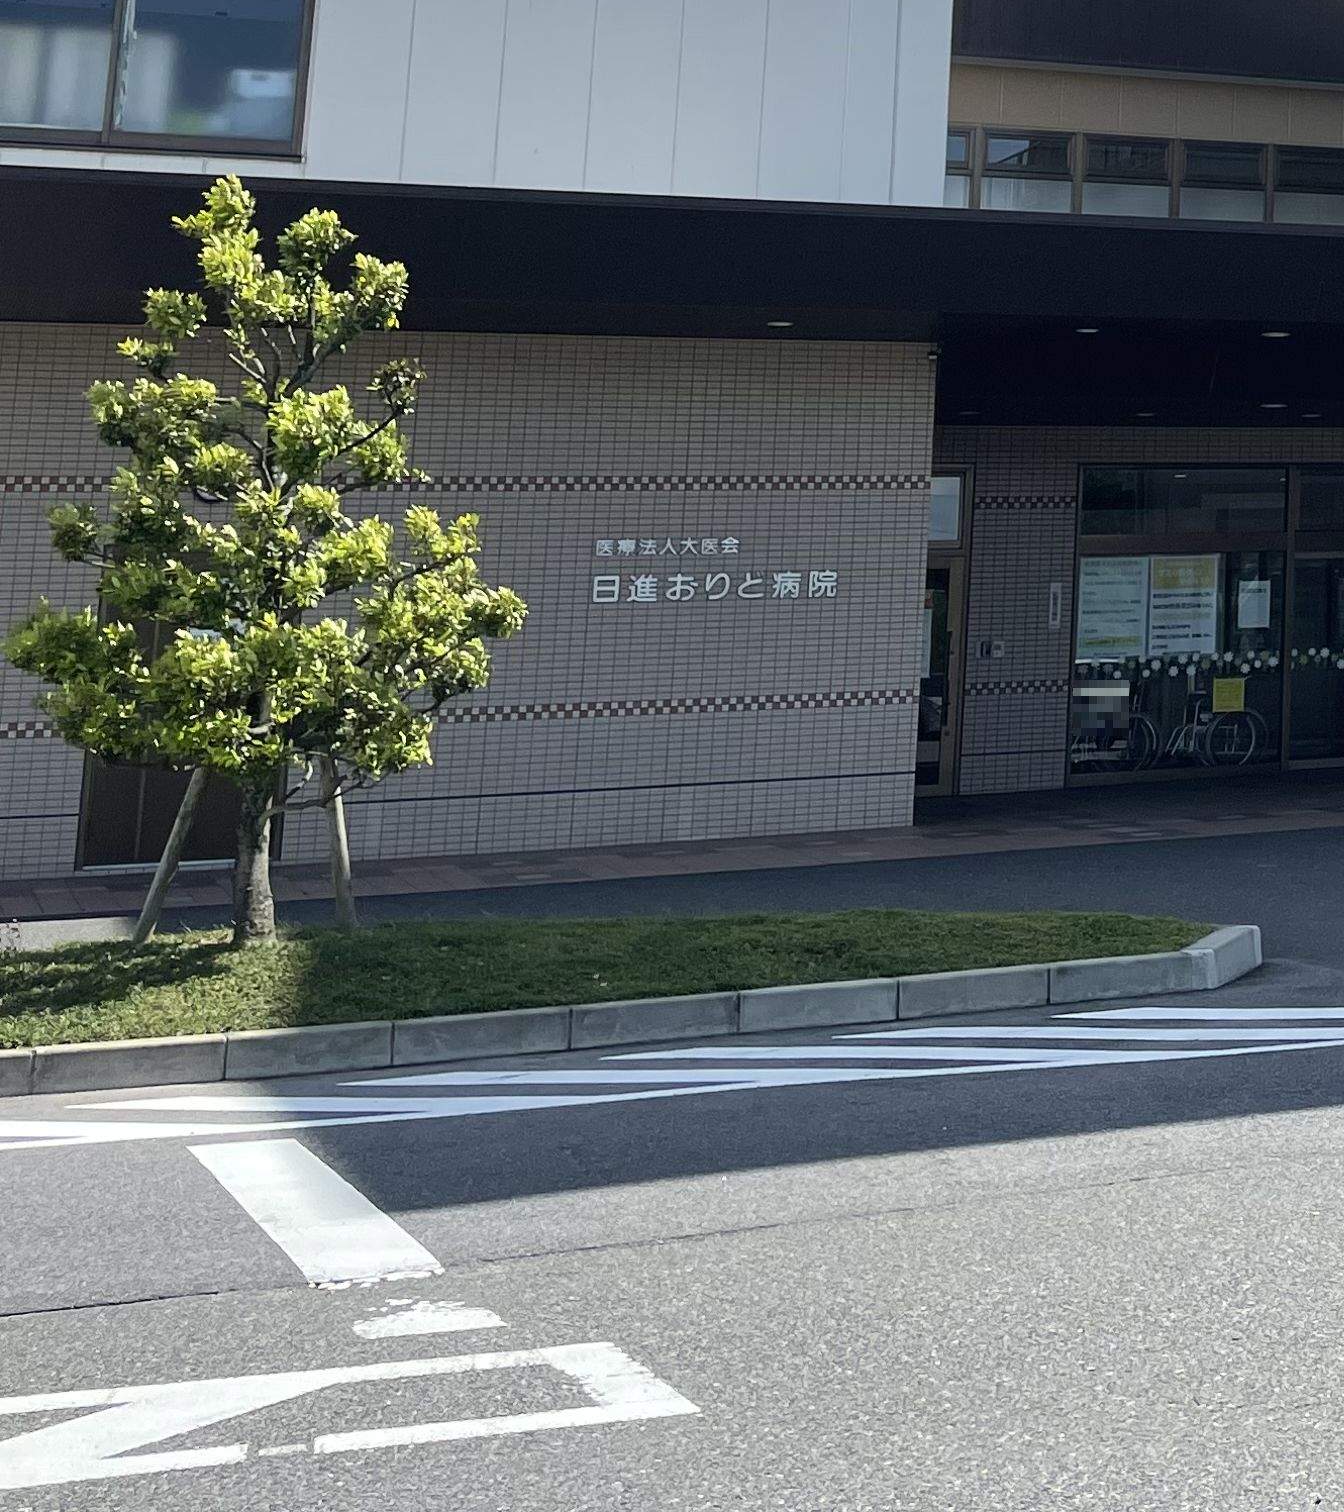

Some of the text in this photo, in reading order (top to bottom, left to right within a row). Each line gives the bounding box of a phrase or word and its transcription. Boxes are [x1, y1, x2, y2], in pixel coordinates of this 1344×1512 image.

[595, 535, 741, 557] 医療法人大医会
[592, 569, 838, 603] 日進おりど病院
